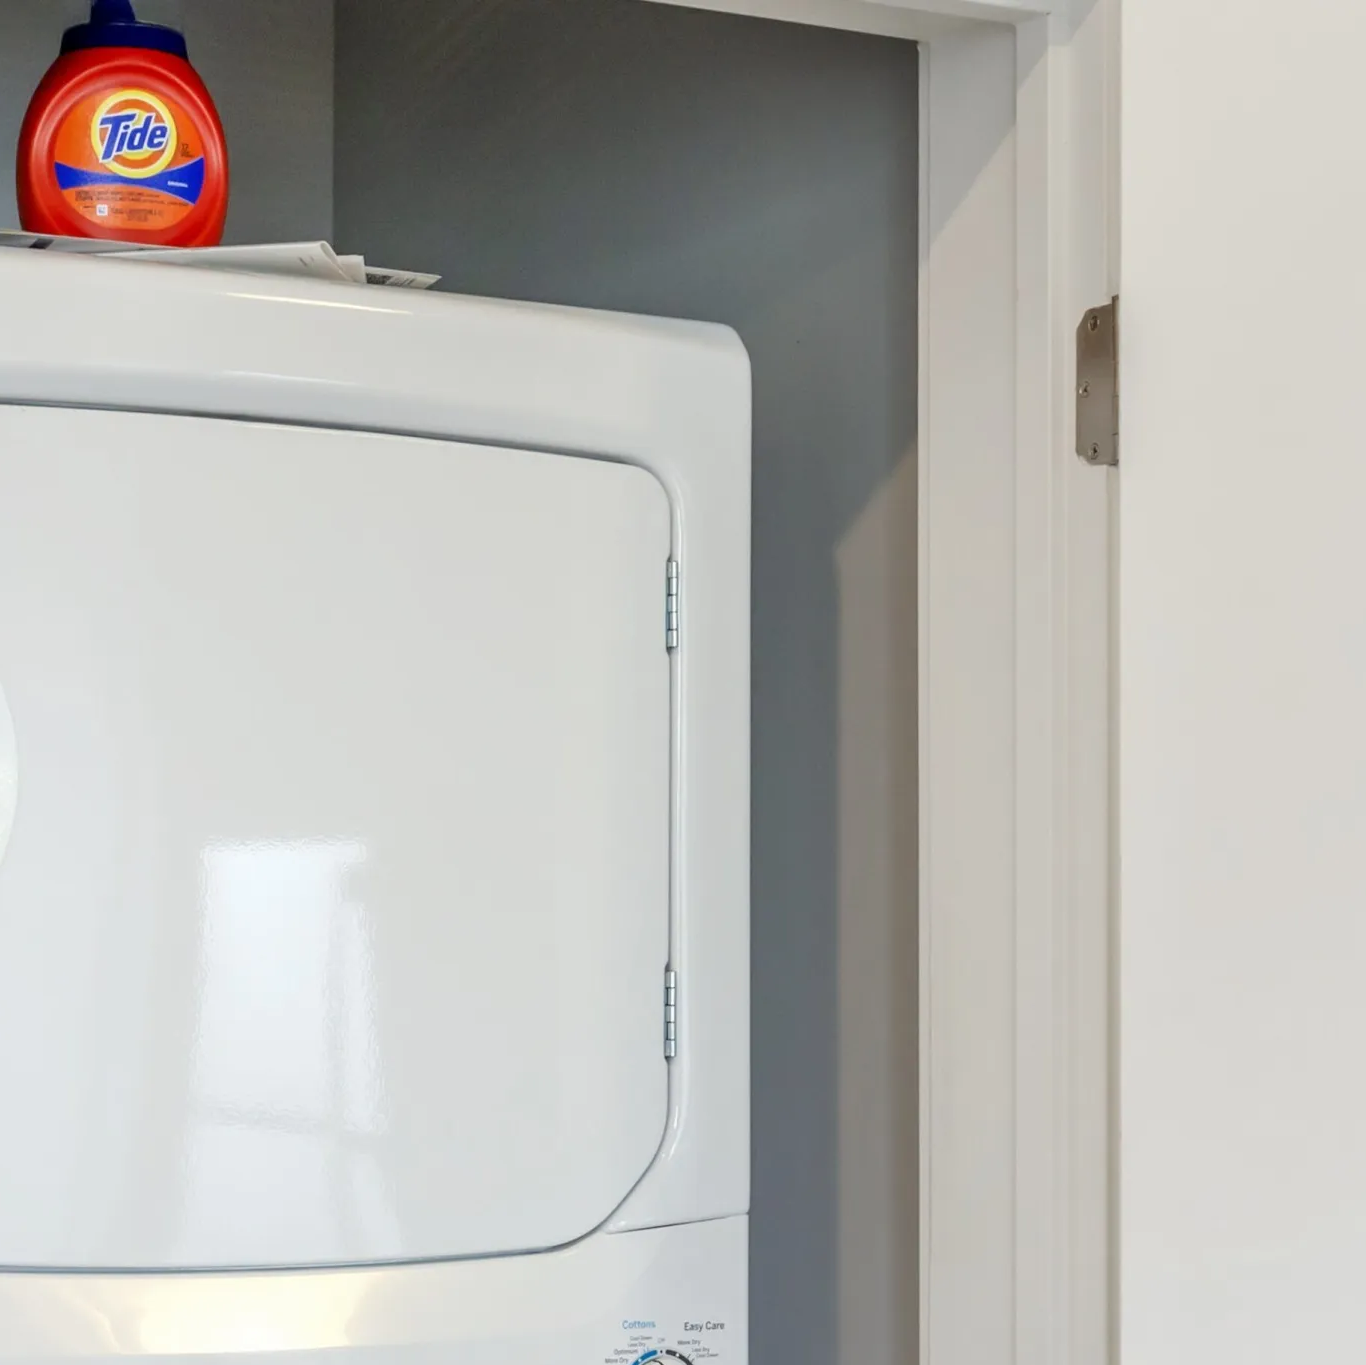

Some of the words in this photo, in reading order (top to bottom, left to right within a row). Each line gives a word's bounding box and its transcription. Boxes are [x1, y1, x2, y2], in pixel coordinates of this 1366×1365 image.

[99, 110, 169, 163] Tide
[622, 1320, 656, 1330] Cottons
[684, 1322, 702, 1332] Easy
[706, 1321, 724, 1330] Care
